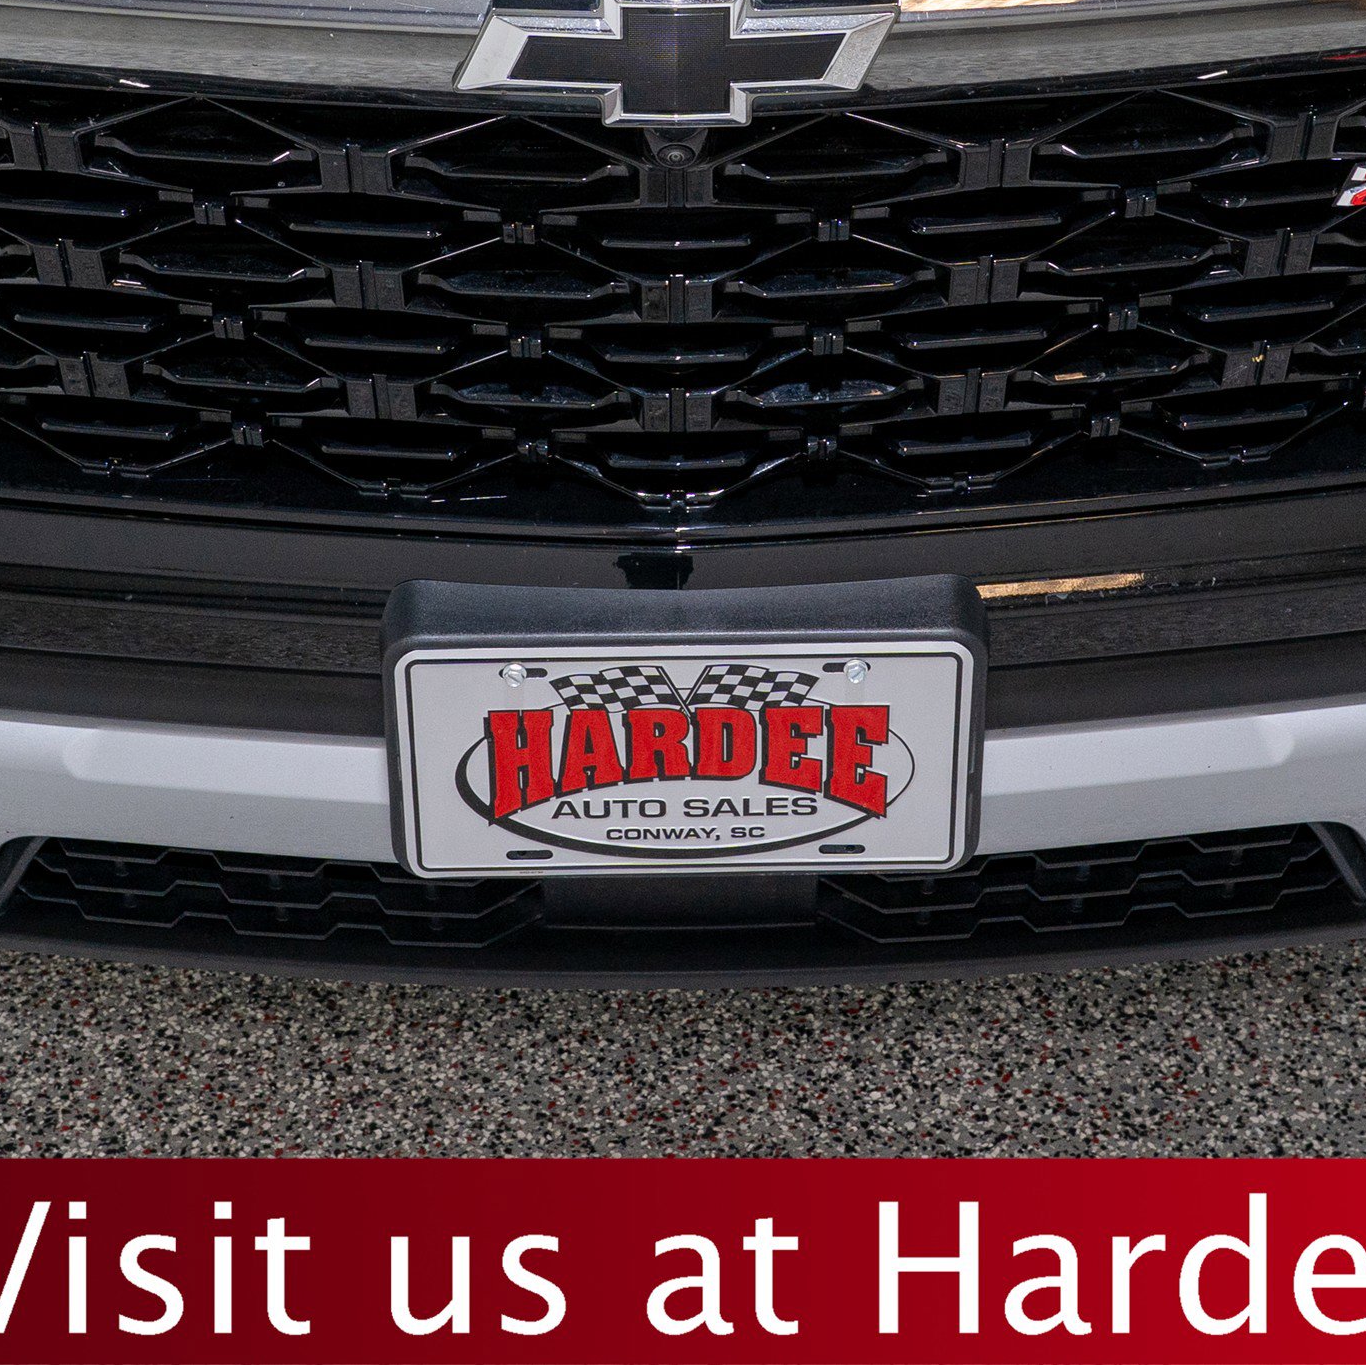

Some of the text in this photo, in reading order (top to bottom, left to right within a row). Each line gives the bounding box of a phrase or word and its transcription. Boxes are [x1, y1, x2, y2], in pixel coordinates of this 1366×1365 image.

[483, 704, 890, 825] HARDEE
[551, 796, 818, 820] AUTO SALES
[605, 826, 766, 841] CONWAY, SC
